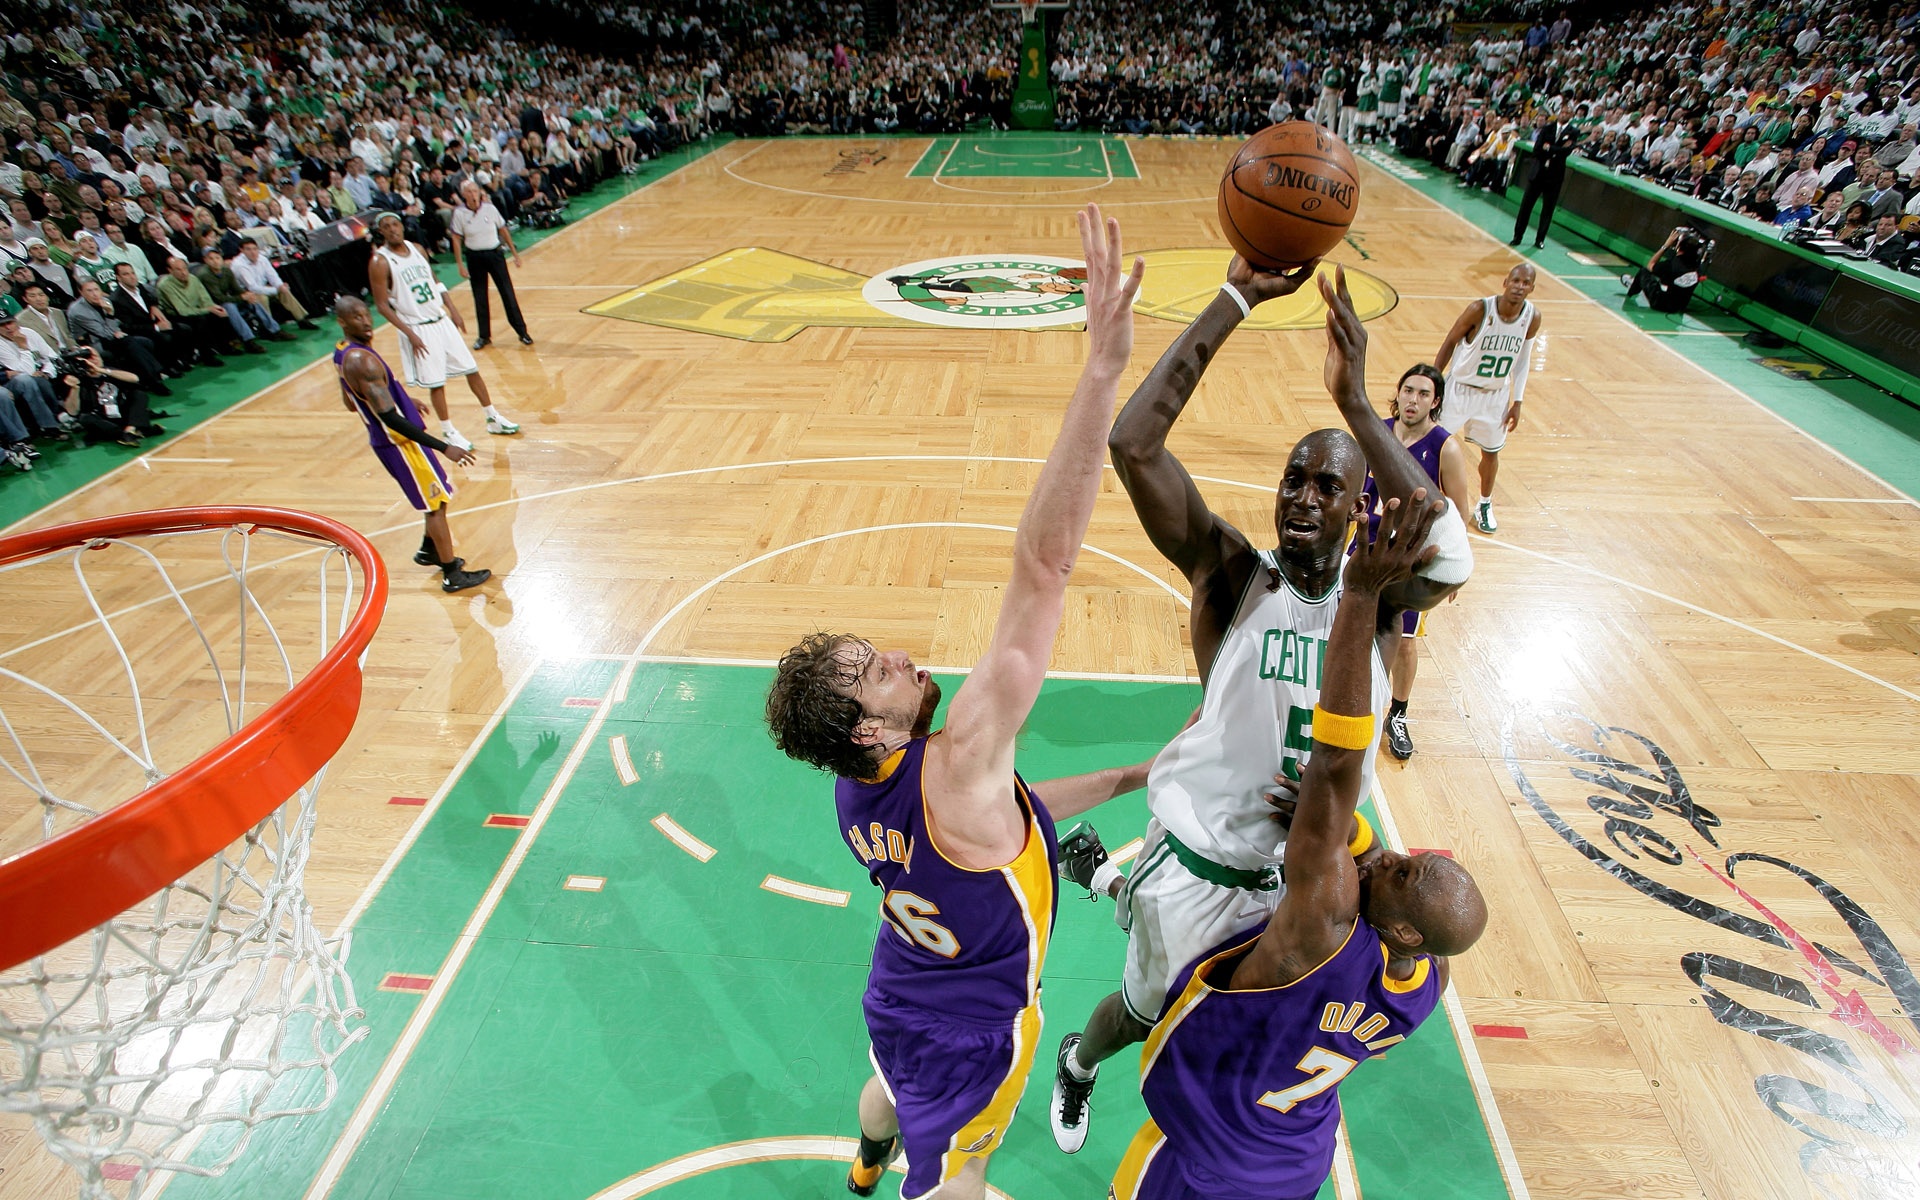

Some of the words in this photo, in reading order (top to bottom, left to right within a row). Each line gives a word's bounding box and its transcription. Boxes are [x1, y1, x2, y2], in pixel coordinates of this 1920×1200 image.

[1264, 161, 1355, 210] SPALDING
[939, 261, 1057, 274] BOSTON
[411, 282, 435, 304] 34
[946, 301, 1076, 316] CELTICS
[1480, 334, 1523, 354] CELTICS
[1476, 354, 1514, 378] 20
[1256, 1045, 1359, 1114] 7
